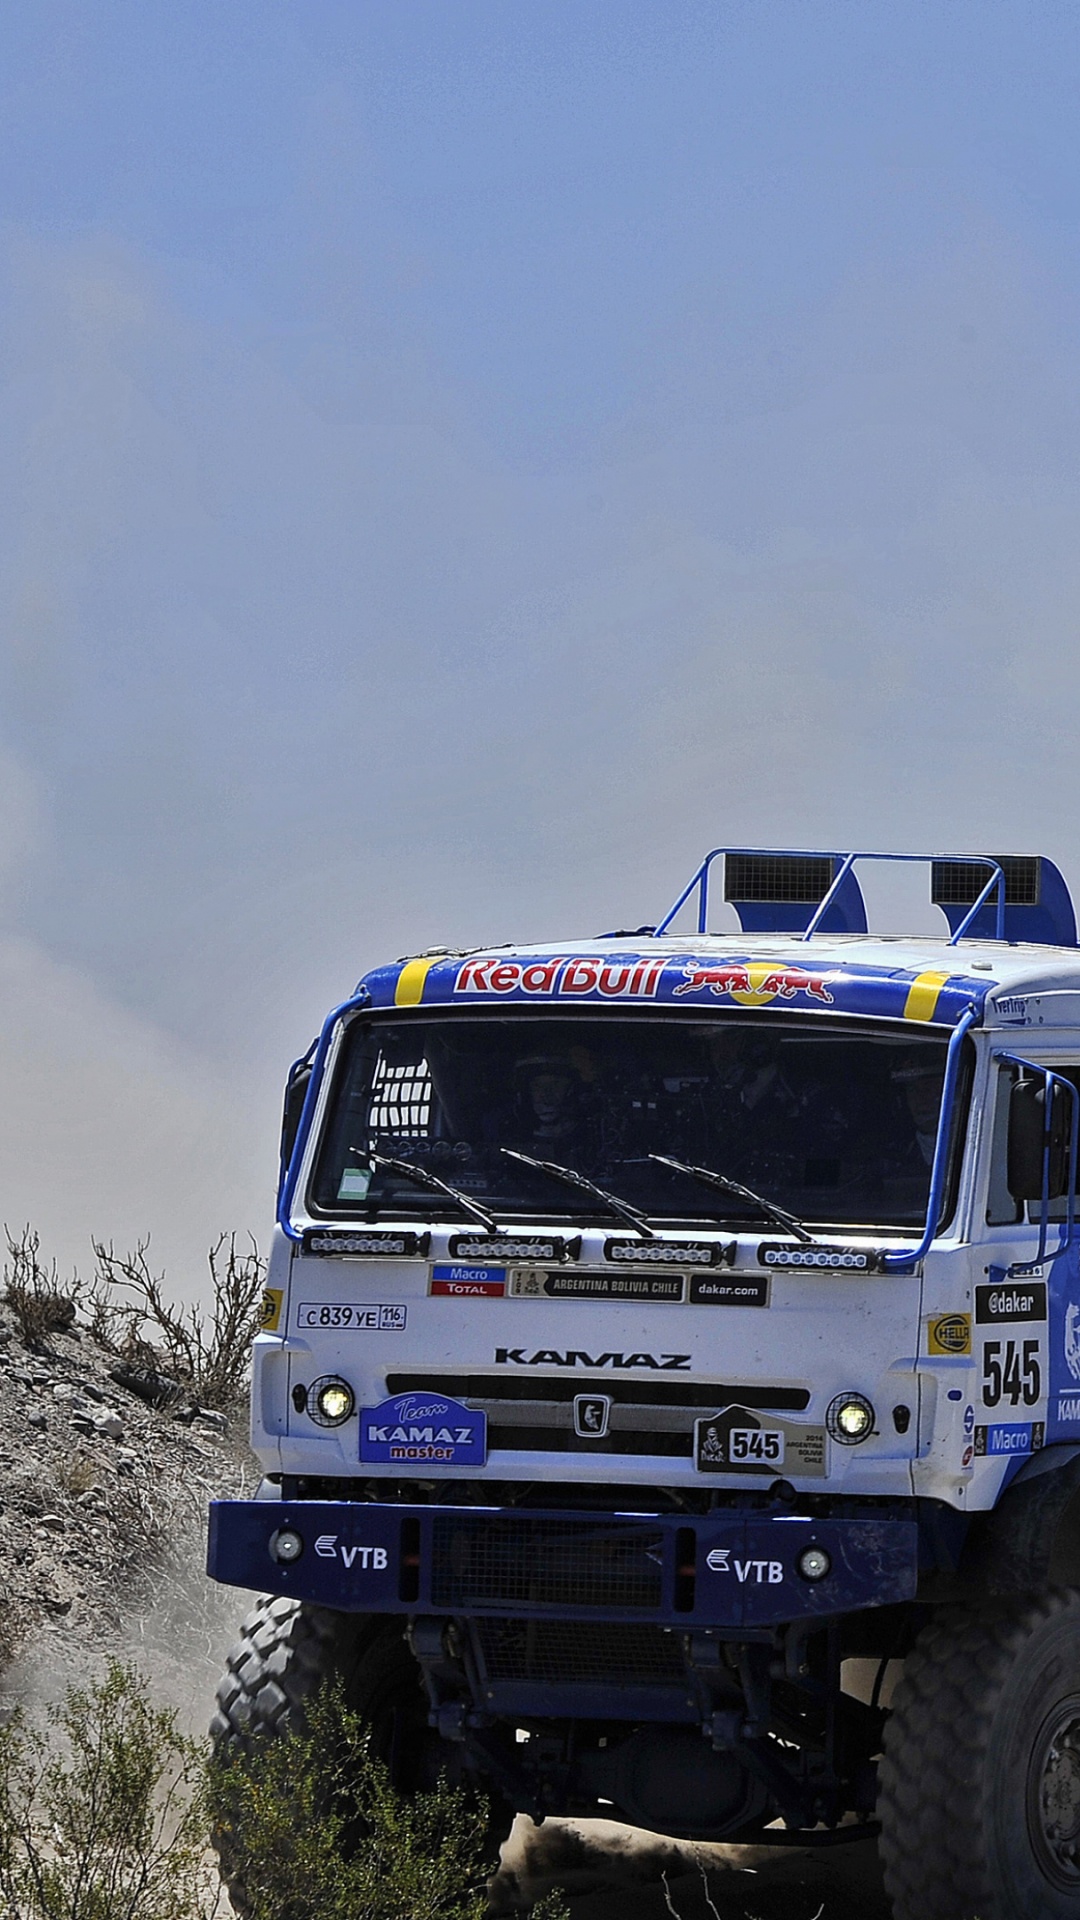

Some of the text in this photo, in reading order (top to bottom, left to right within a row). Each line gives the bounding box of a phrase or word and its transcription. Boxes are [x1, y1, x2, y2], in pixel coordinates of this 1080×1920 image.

[455, 958, 667, 997] Red Bull
[451, 1267, 488, 1280] Macro
[553, 1279, 679, 1295] ARGENTINA BOLIVIA CHILE
[698, 1284, 759, 1297] dakar.com
[988, 1291, 1034, 1313] @dakar
[382, 1308, 400, 1321] 116
[939, 1327, 969, 1340] HELLA
[495, 1348, 691, 1370] KAMAZ
[982, 1340, 1041, 1407] 545
[394, 1397, 448, 1423] Team
[368, 1426, 473, 1444] KAMAZ
[733, 1432, 780, 1459] 545
[992, 1429, 1028, 1450] Macro
[390, 1445, 454, 1460] master
[341, 1546, 388, 1569] VTB
[733, 1560, 783, 1583] VTB
